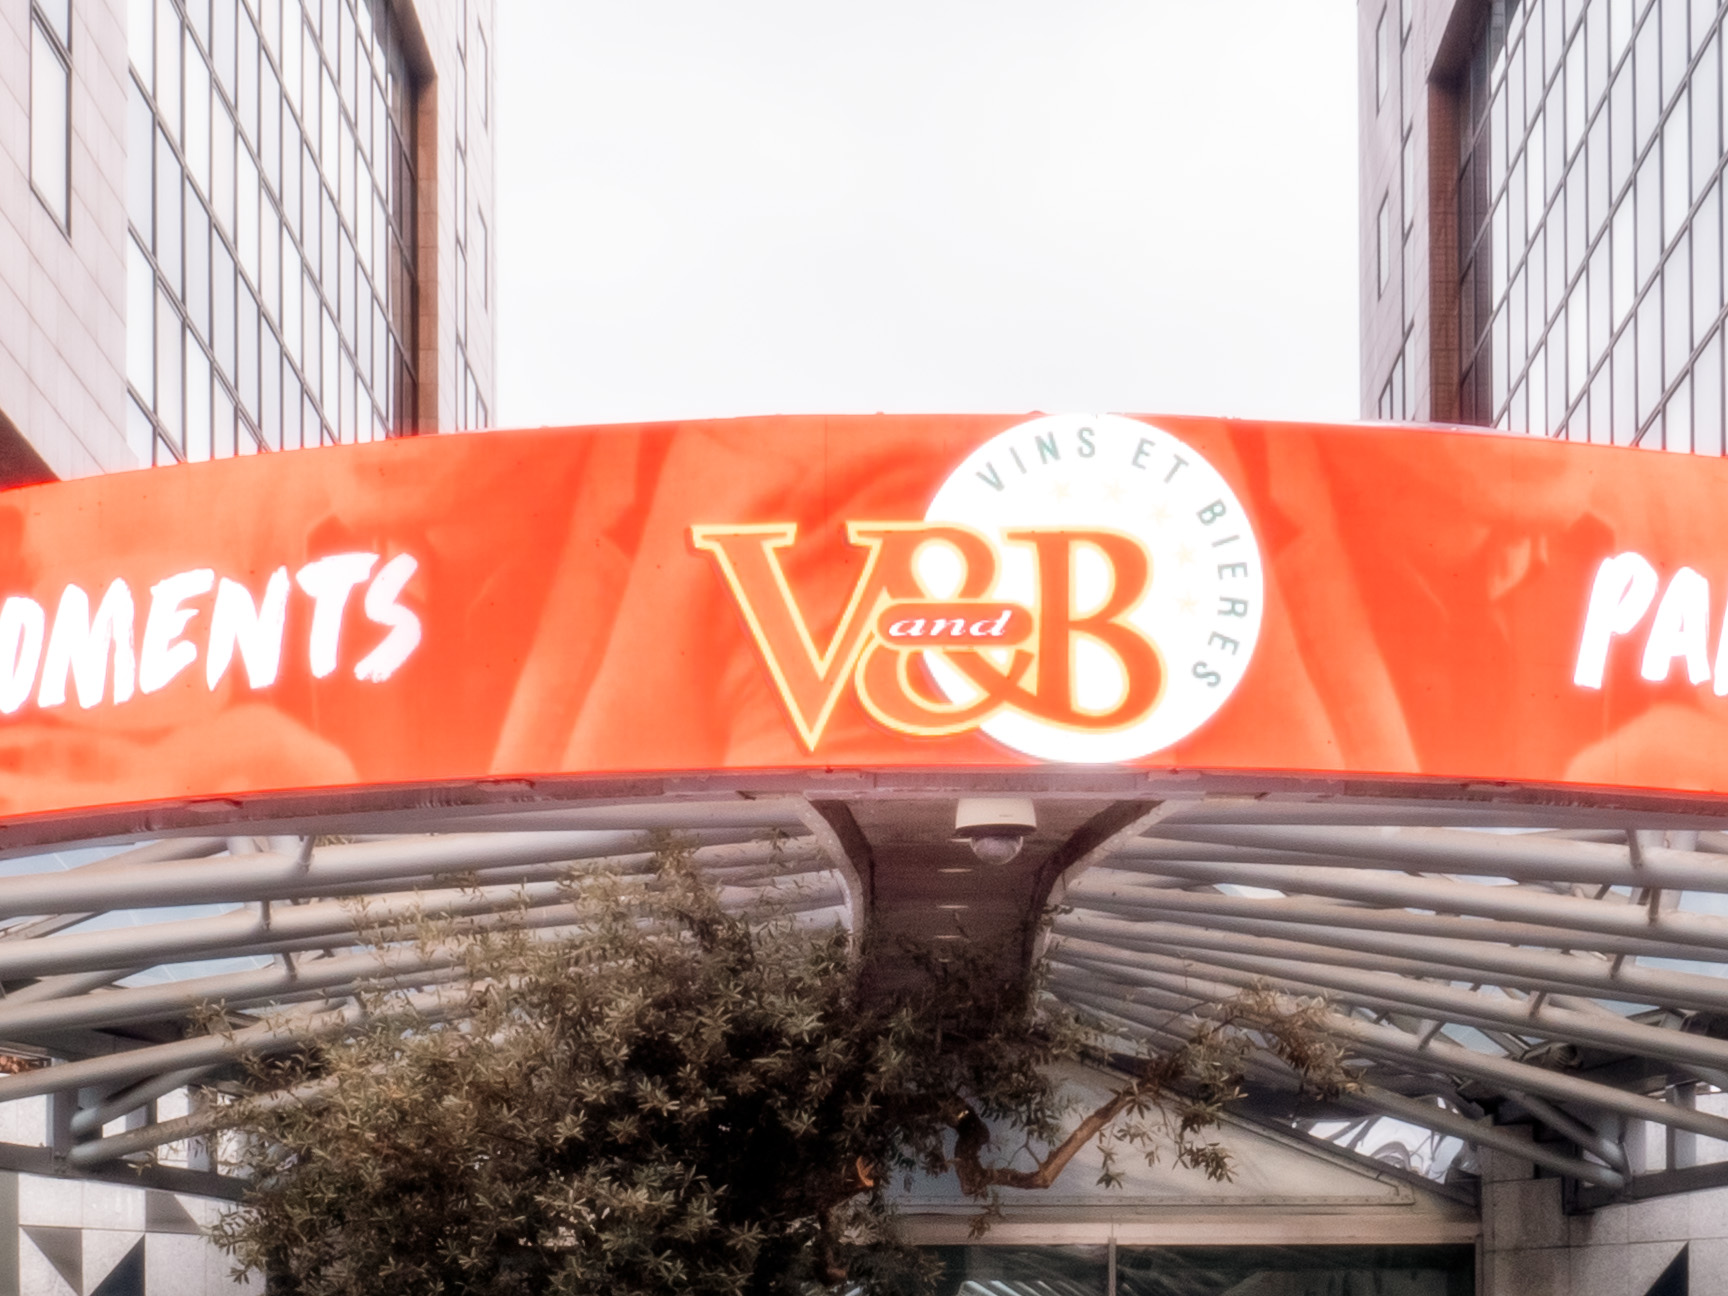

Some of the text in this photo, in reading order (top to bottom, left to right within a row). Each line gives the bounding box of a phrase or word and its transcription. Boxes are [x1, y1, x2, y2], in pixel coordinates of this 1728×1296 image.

[888, 608, 1015, 639] and
[976, 425, 1250, 689] VINS ET BIERES
